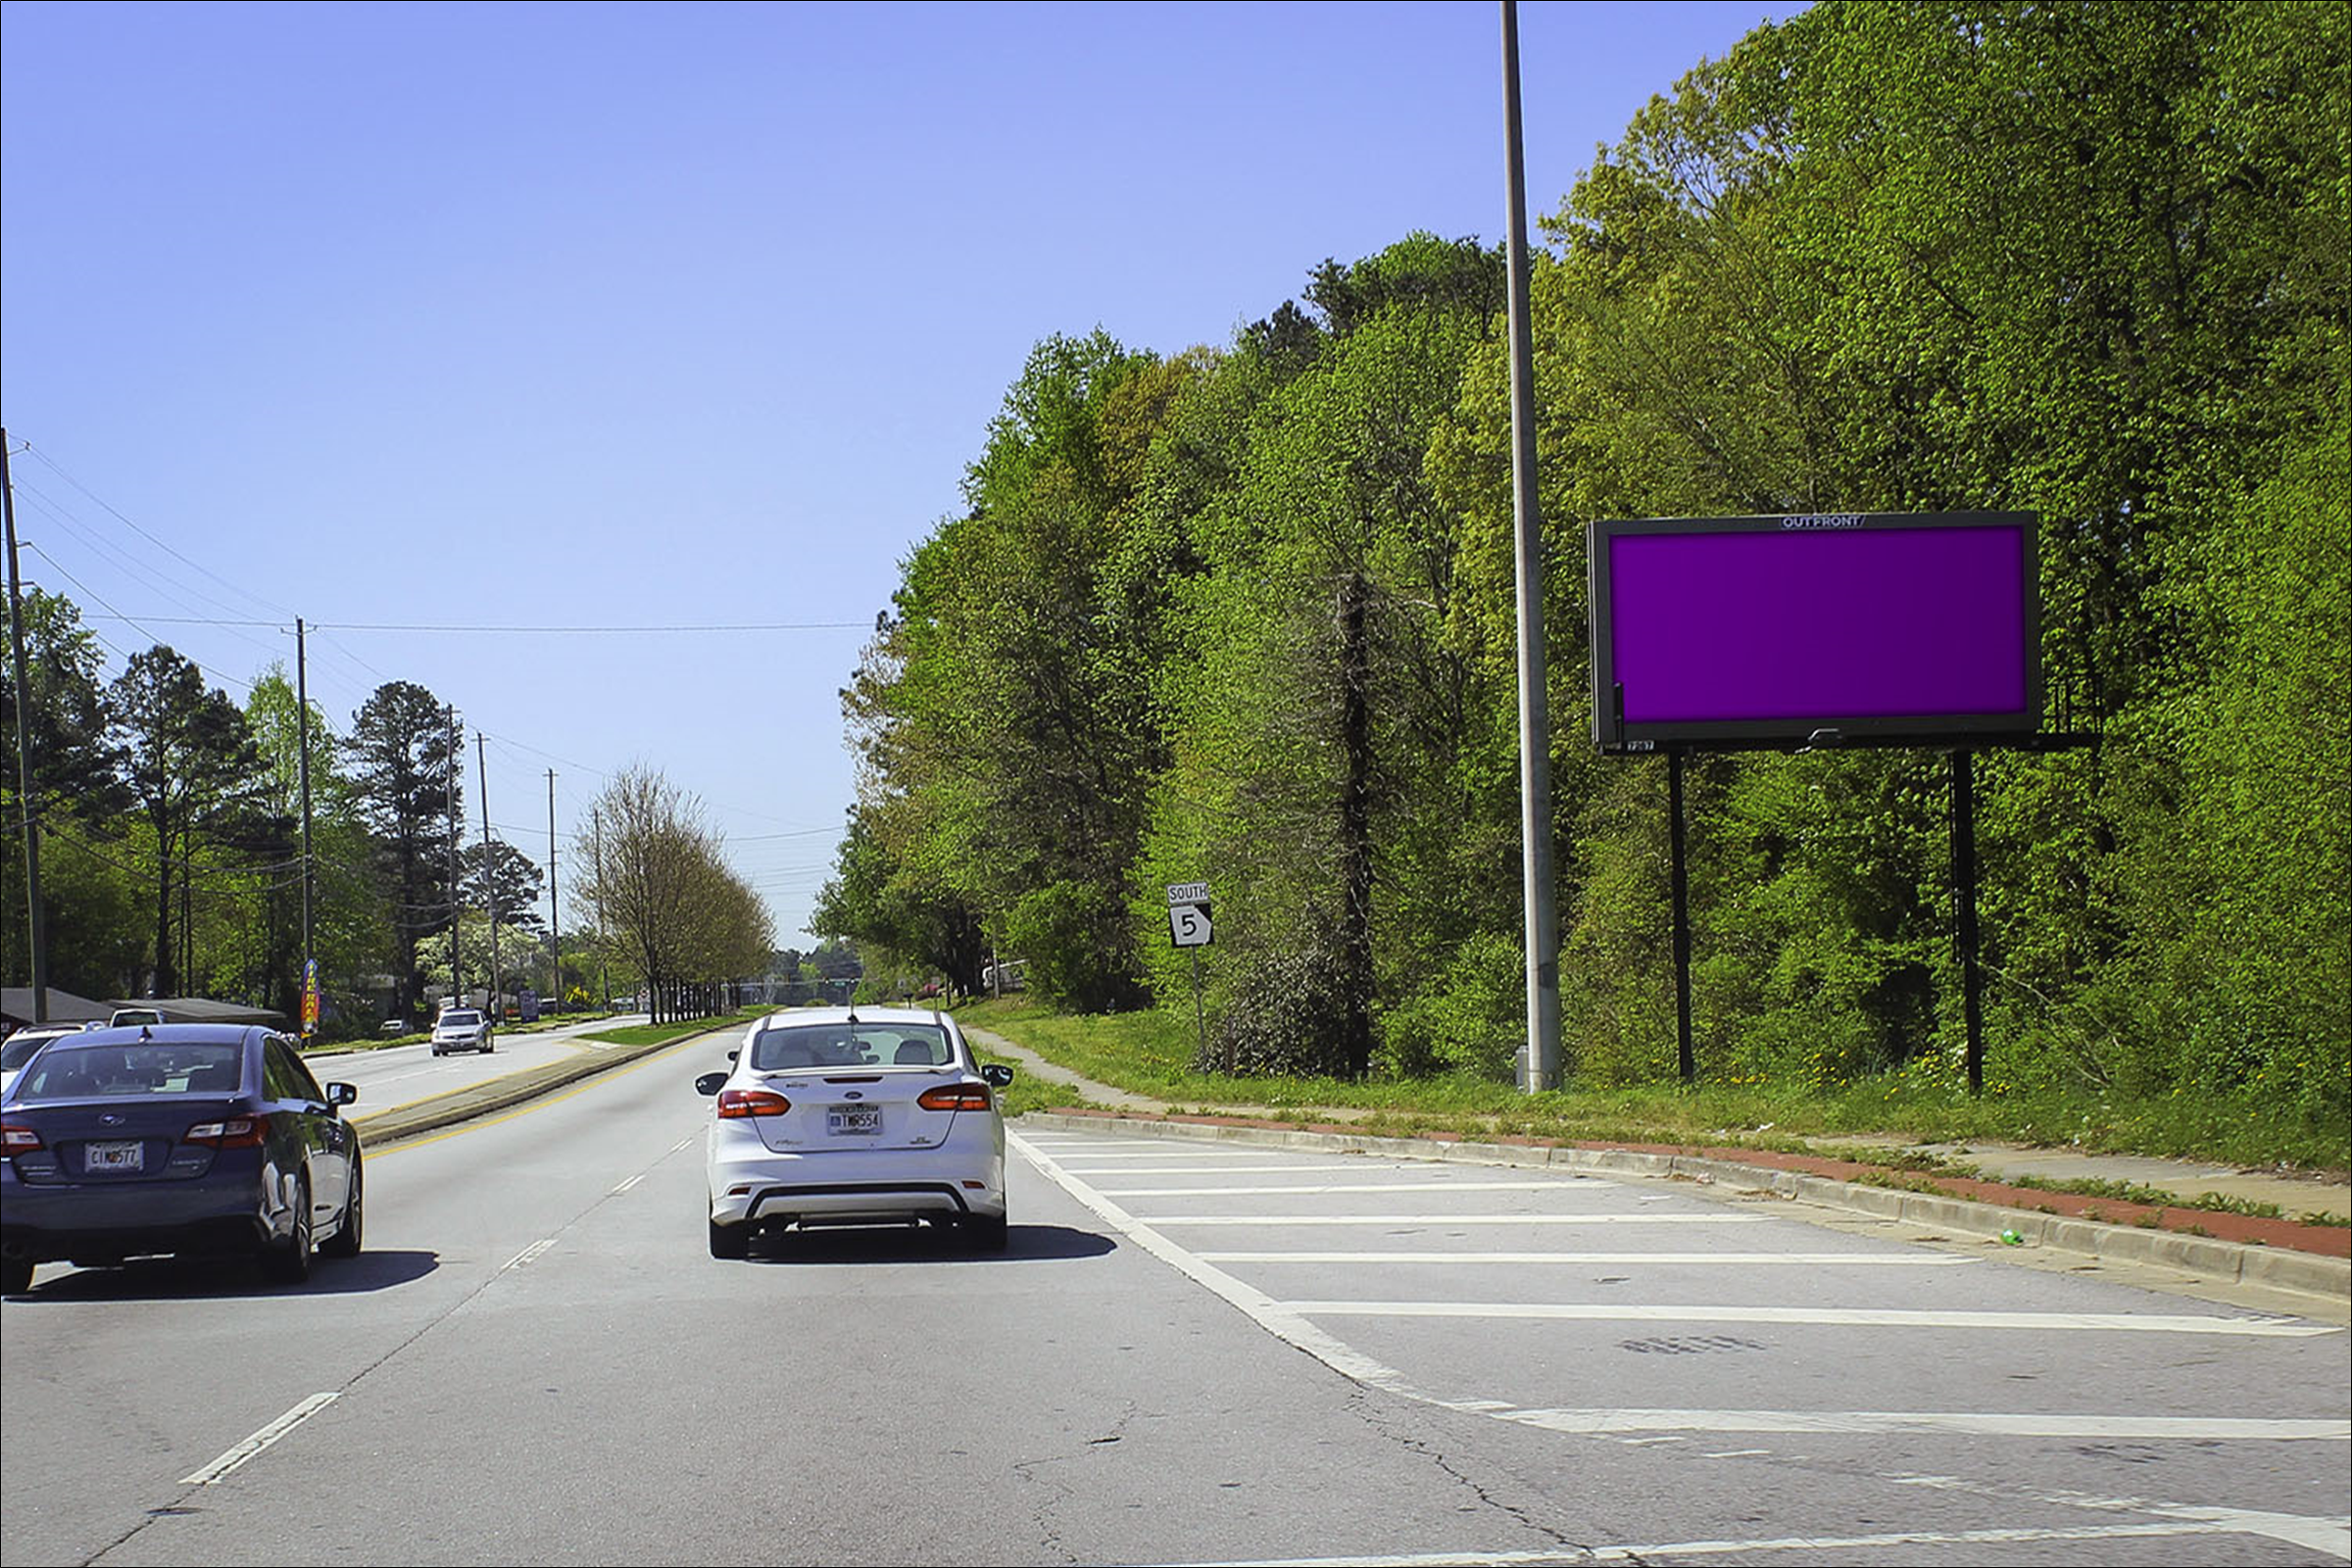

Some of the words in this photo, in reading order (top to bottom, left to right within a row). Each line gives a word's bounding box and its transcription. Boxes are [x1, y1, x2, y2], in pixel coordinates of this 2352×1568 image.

[1783, 515, 1859, 528] OUTFRONT
[1169, 886, 1206, 901] SOUTH
[1182, 914, 1197, 937] 5
